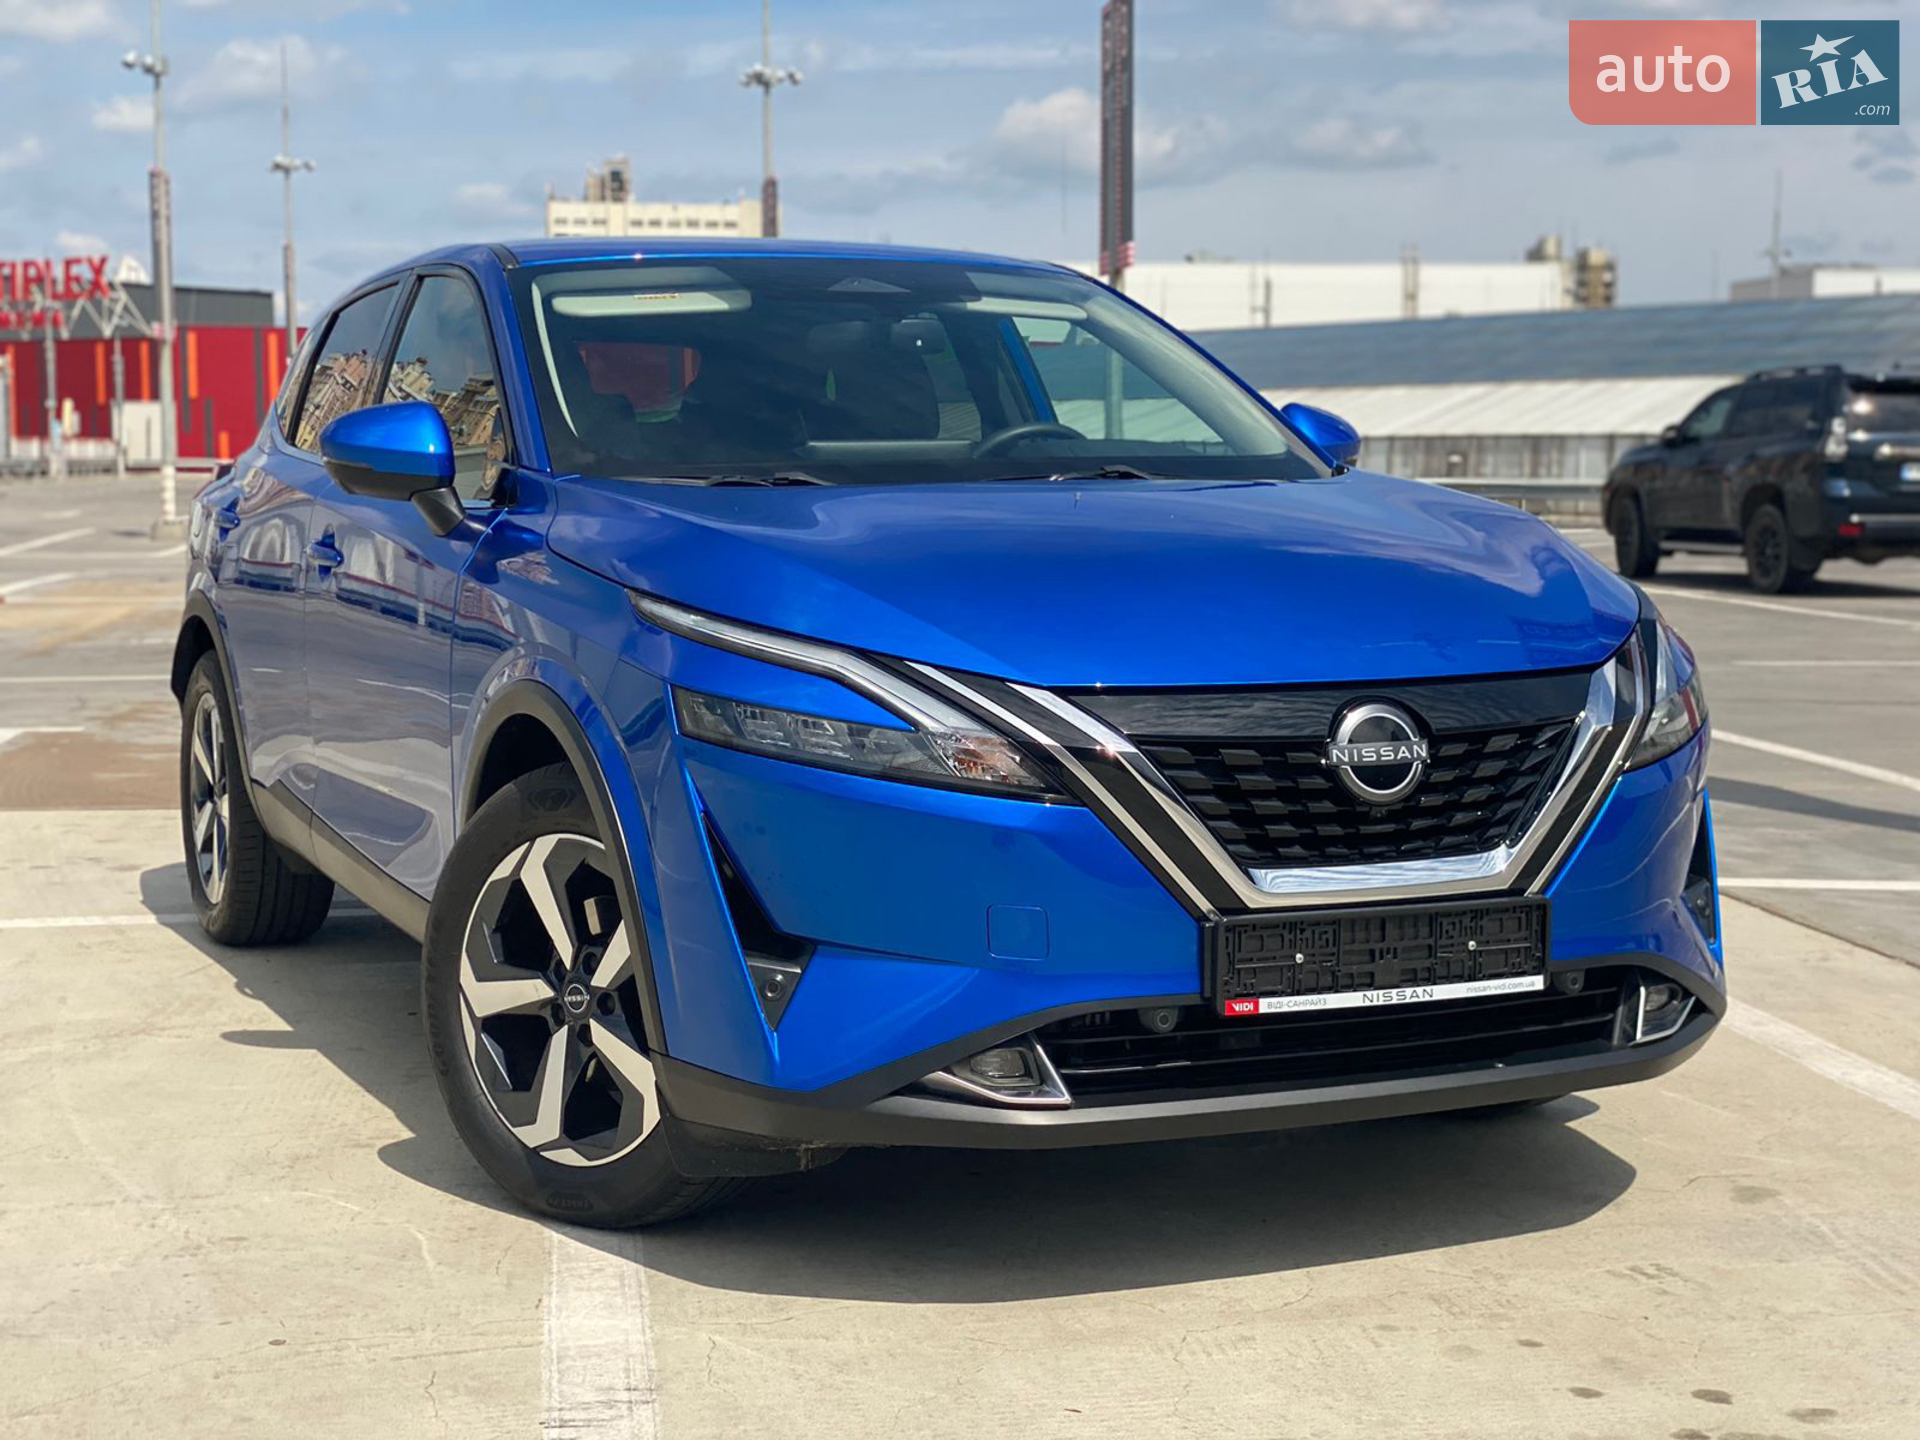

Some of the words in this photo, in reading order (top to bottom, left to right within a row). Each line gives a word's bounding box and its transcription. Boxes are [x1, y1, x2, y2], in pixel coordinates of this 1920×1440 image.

[1332, 744, 1427, 763] NISSAN
[1466, 981, 1536, 994] nissan-vidi.com.ua
[1362, 988, 1434, 1004] NISSAN
[1231, 1002, 1254, 1012] VIDI
